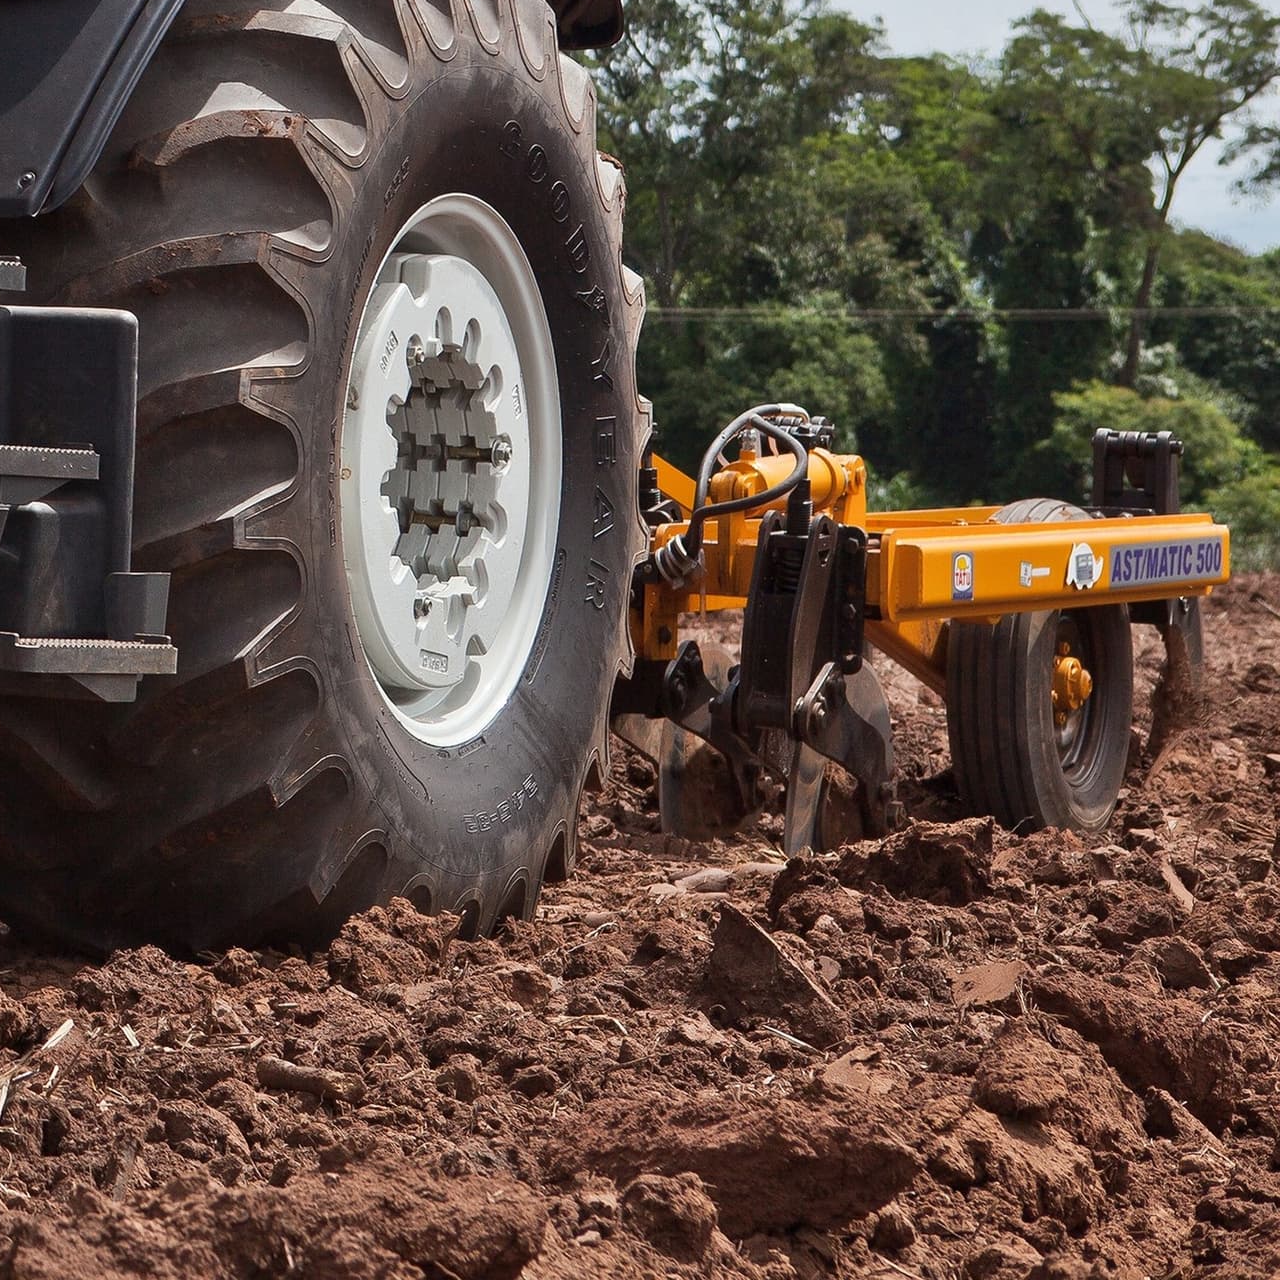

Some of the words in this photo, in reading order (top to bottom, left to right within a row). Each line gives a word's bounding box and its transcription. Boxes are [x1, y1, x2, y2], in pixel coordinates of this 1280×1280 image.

[1111, 545, 1193, 583] AST/MATIC
[1196, 540, 1223, 574] 500
[955, 571, 972, 587] TATU
